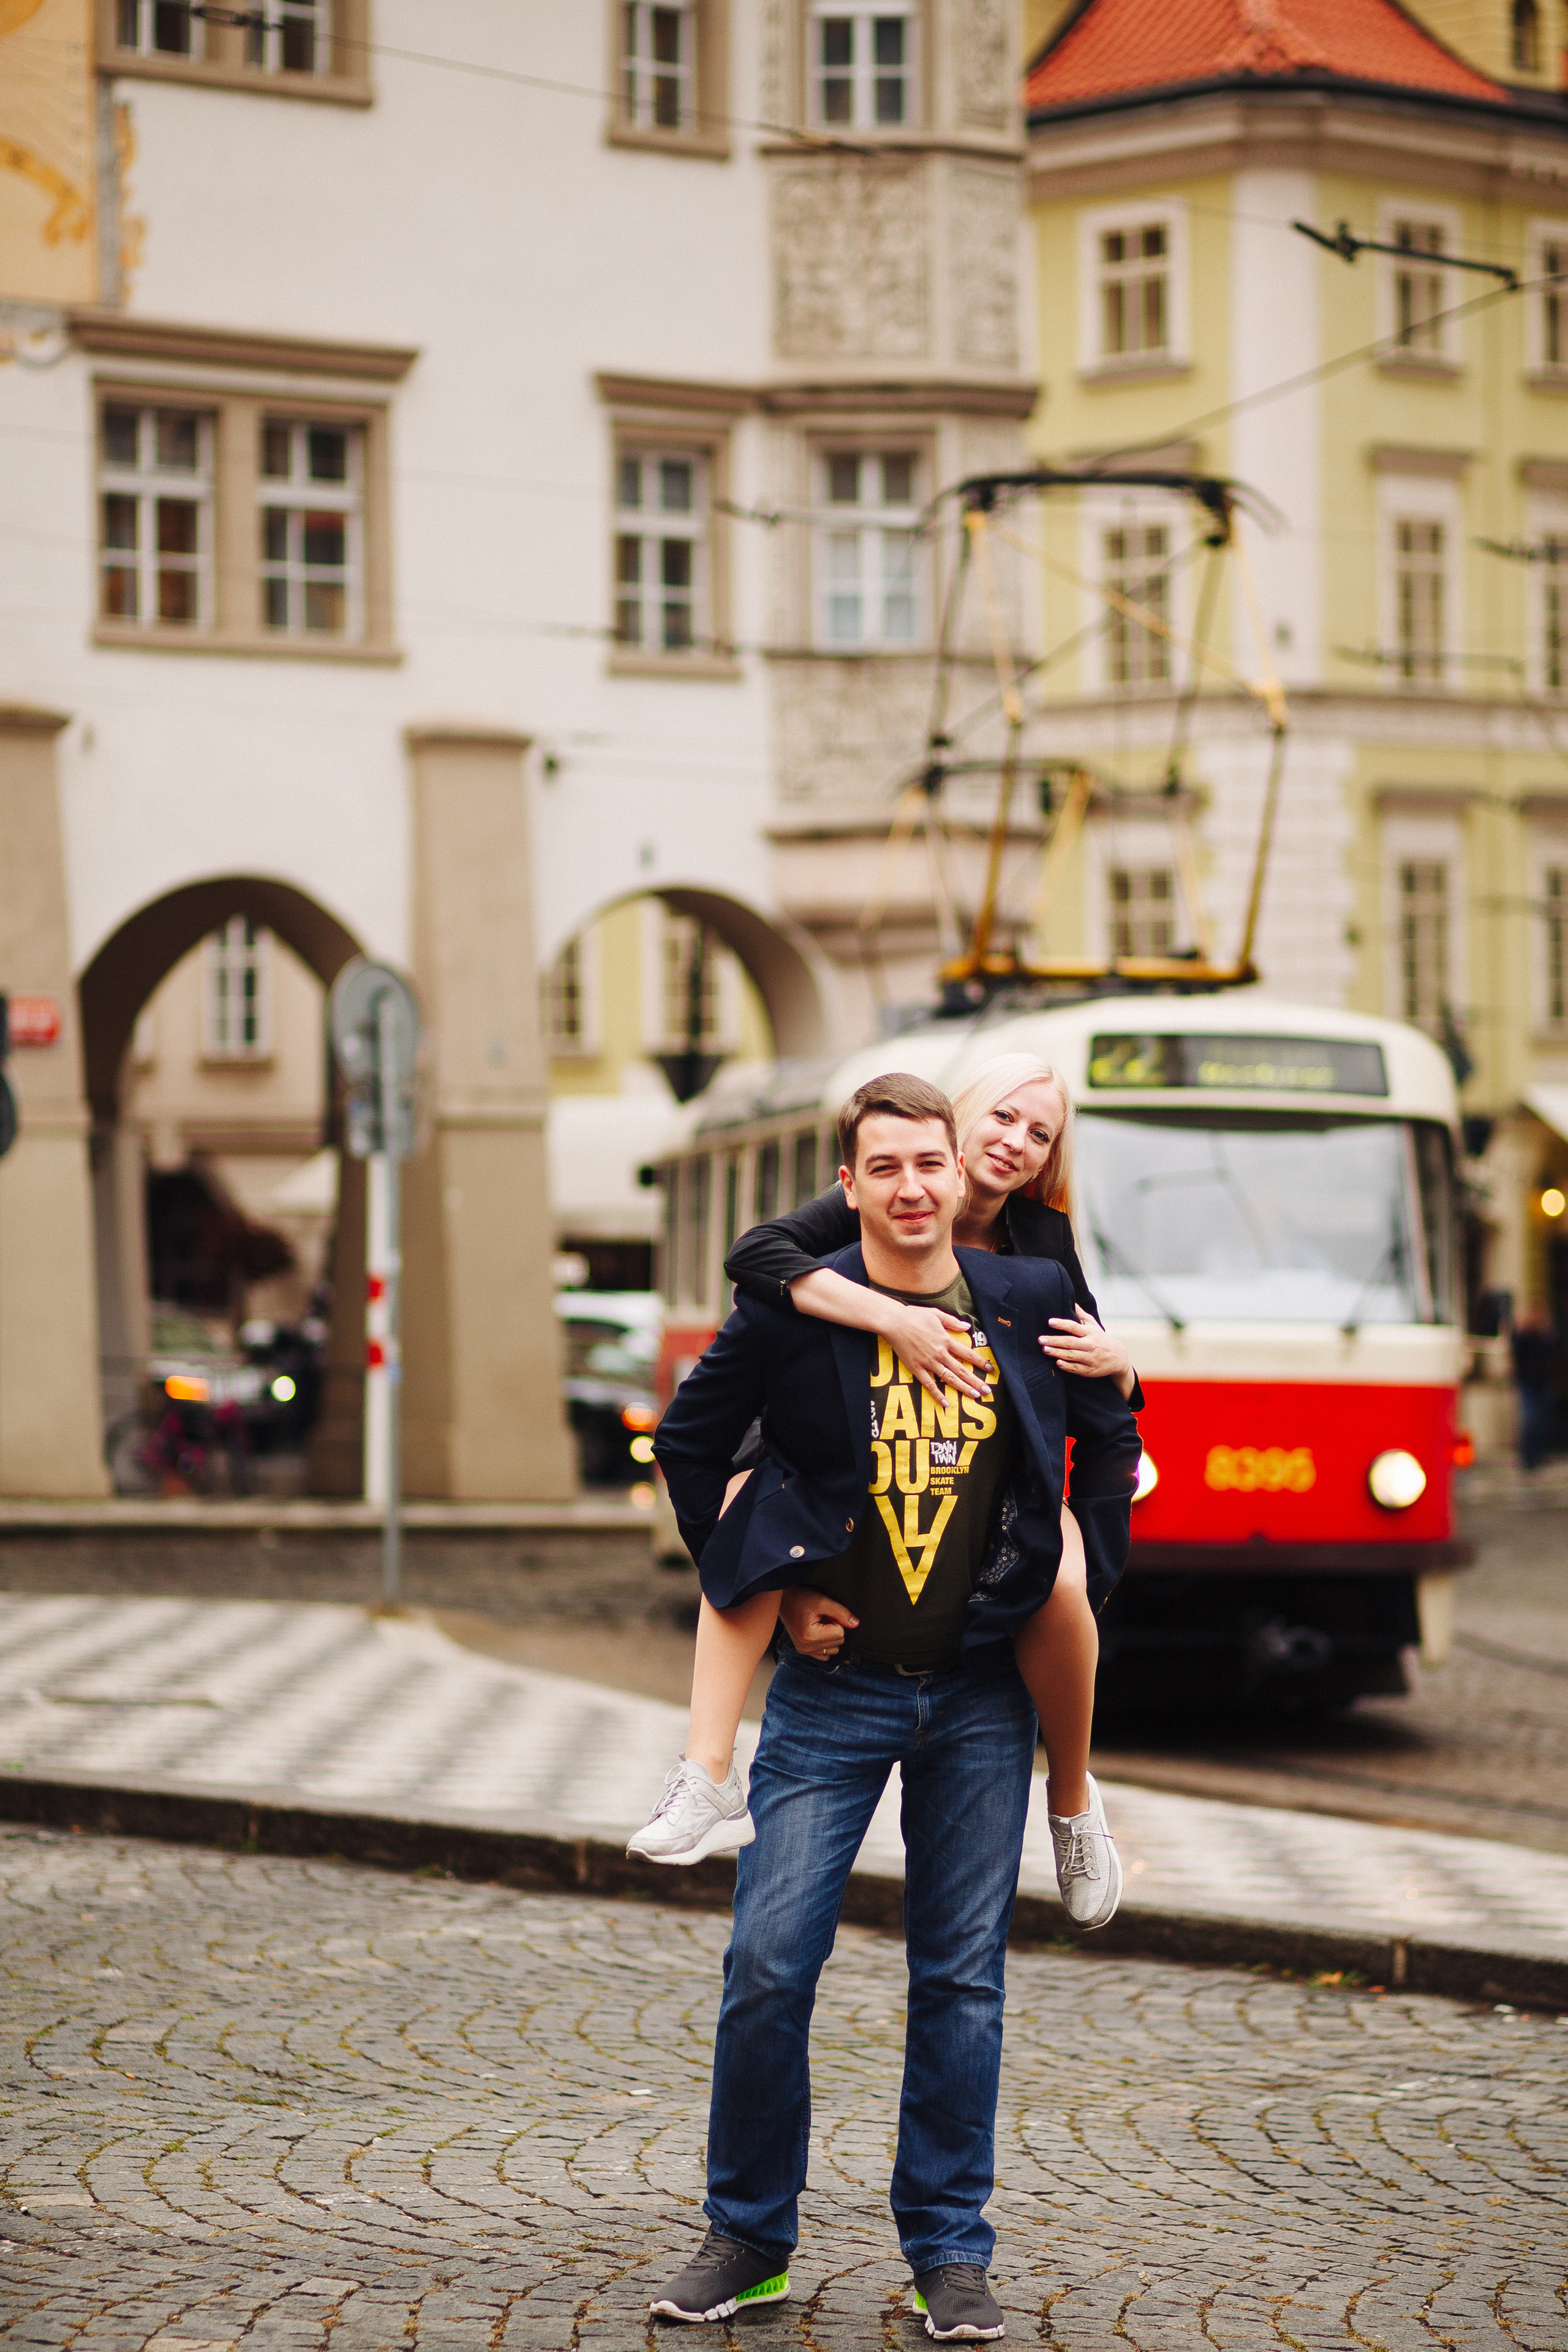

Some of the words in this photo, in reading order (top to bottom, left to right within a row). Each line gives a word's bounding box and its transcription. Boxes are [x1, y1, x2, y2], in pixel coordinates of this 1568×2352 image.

[930, 1466, 969, 1475] BROOKLYN
[930, 1476, 954, 1485] SKATE
[930, 1487, 952, 1496] TEAM
